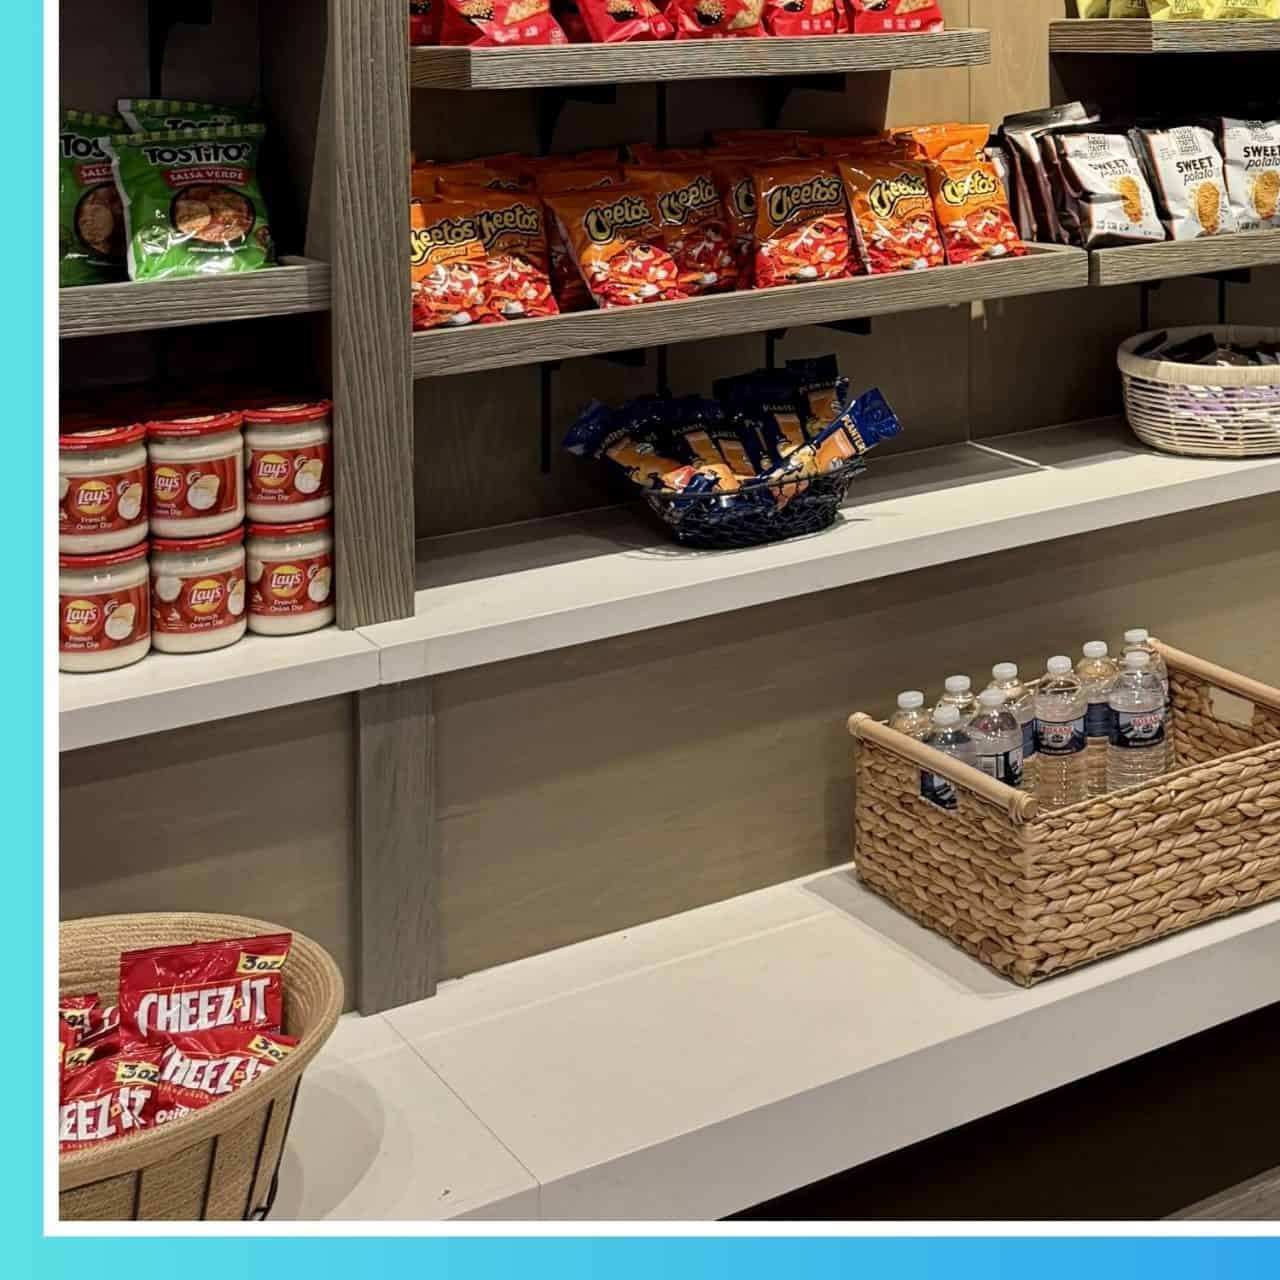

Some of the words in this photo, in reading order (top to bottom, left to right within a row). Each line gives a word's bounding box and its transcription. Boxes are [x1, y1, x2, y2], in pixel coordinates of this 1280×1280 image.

[1175, 156, 1214, 173] SWEET
[1245, 157, 1280, 171] potato
[1183, 168, 1214, 187] potato
[767, 174, 843, 226] Cheetos
[868, 172, 928, 218] Cheetos
